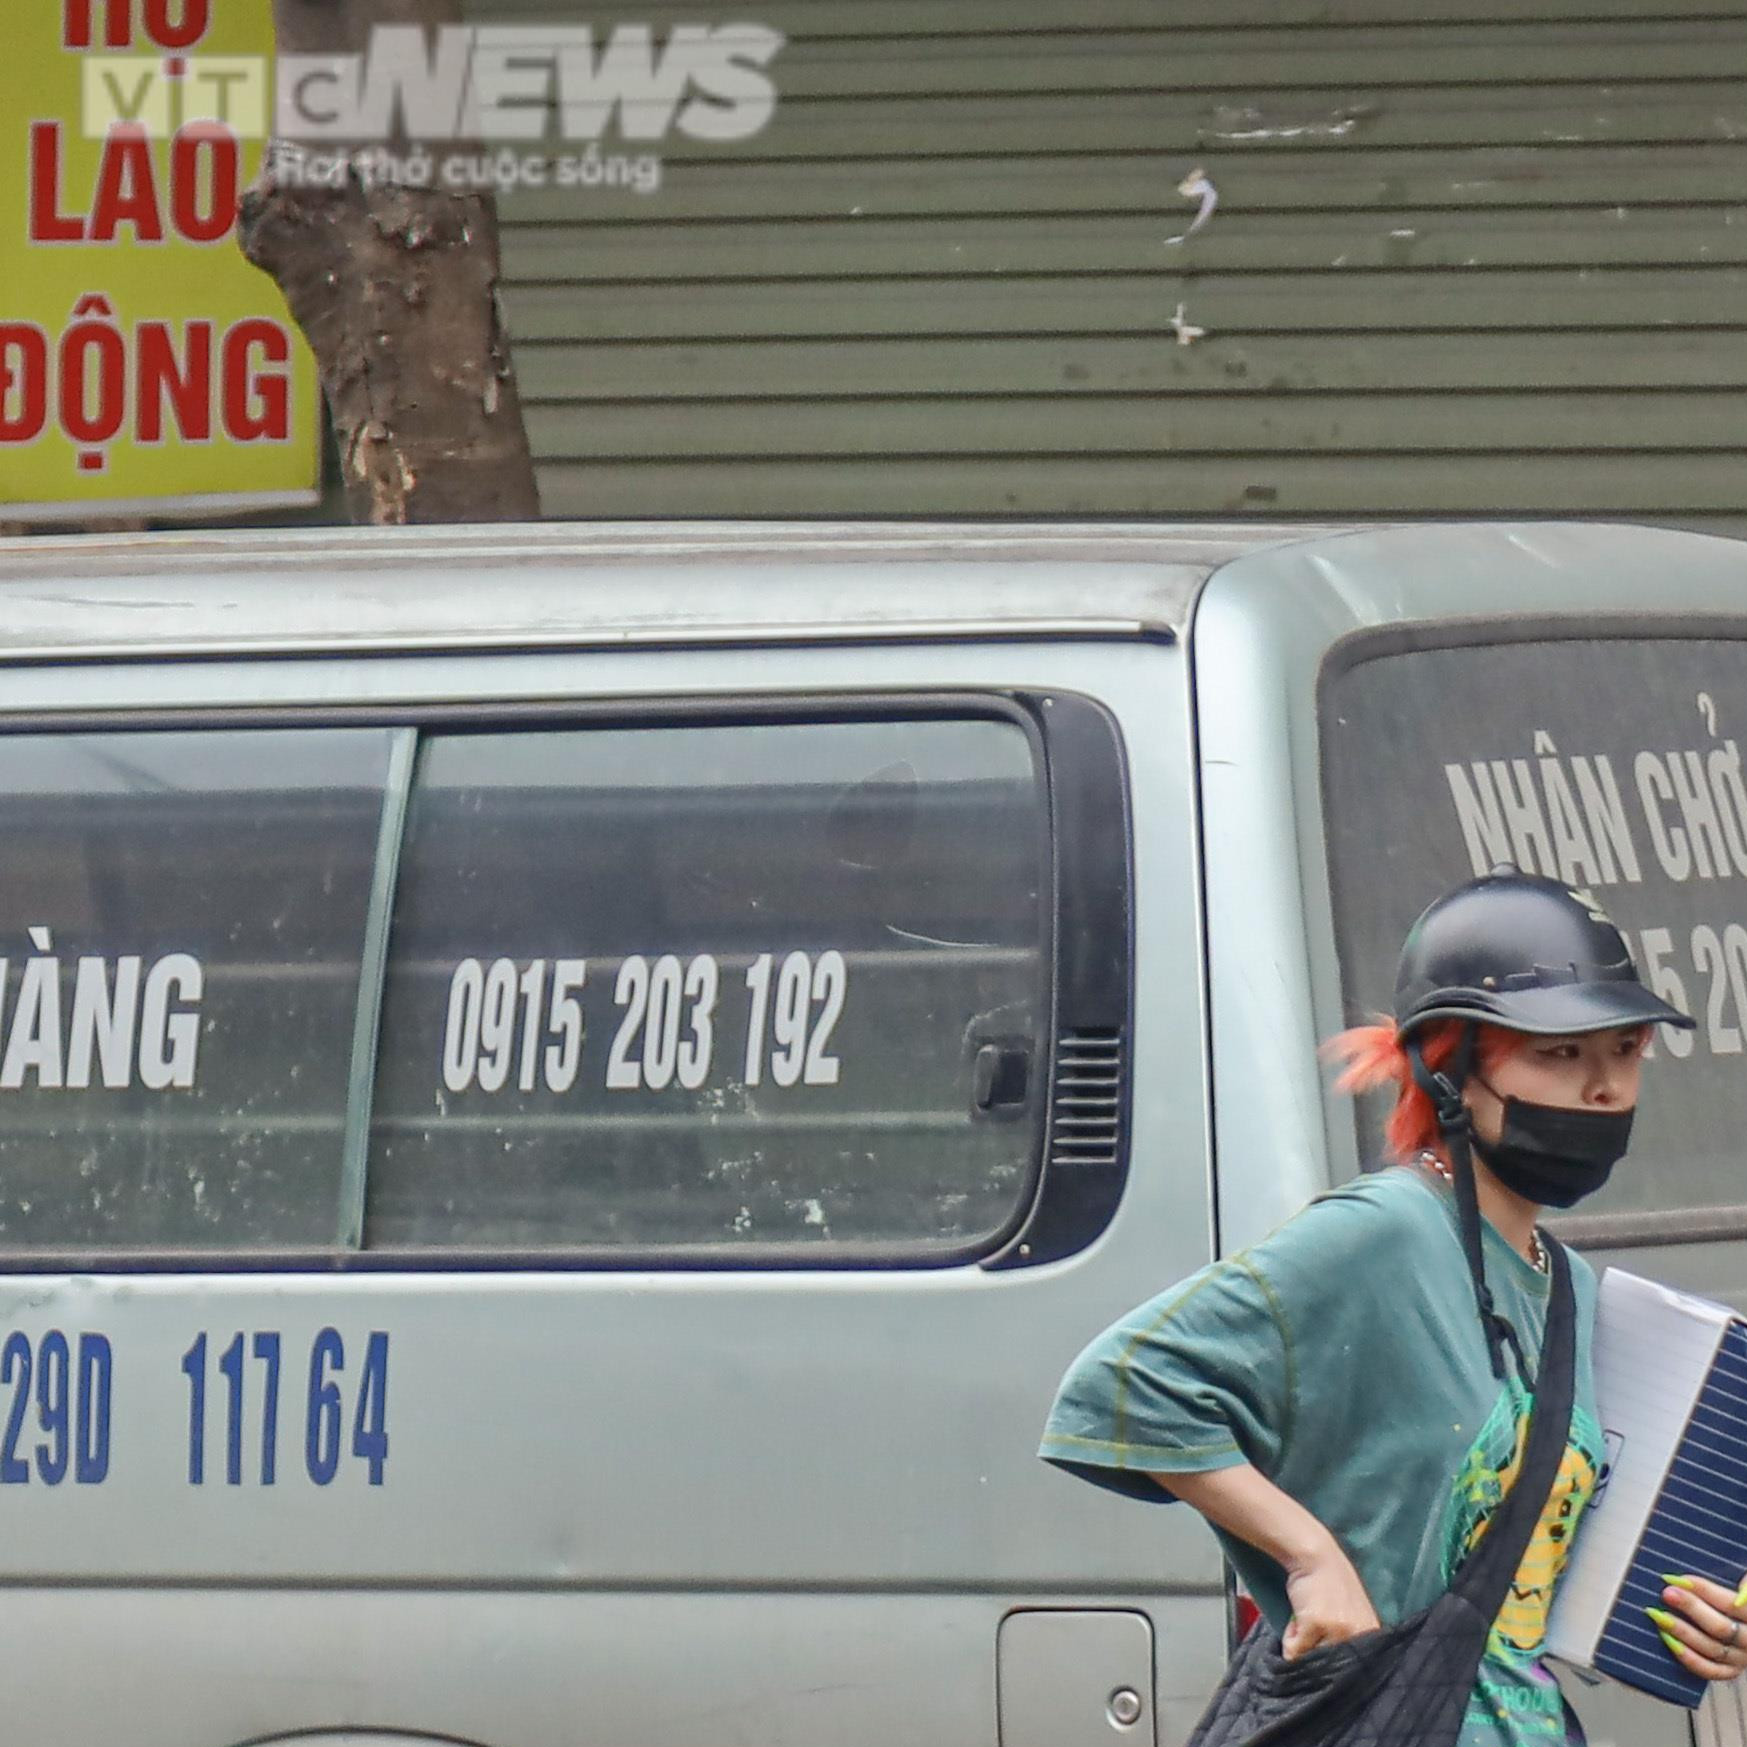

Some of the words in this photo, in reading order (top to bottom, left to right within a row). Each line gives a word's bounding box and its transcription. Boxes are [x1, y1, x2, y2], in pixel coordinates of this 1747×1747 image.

[30, 121, 238, 241] LAO
[0, 926, 203, 1090] ÀNG
[441, 957, 586, 1093] 0915
[606, 954, 720, 1091] 203
[744, 950, 847, 1086] 192
[0, 1328, 113, 1486] 29D
